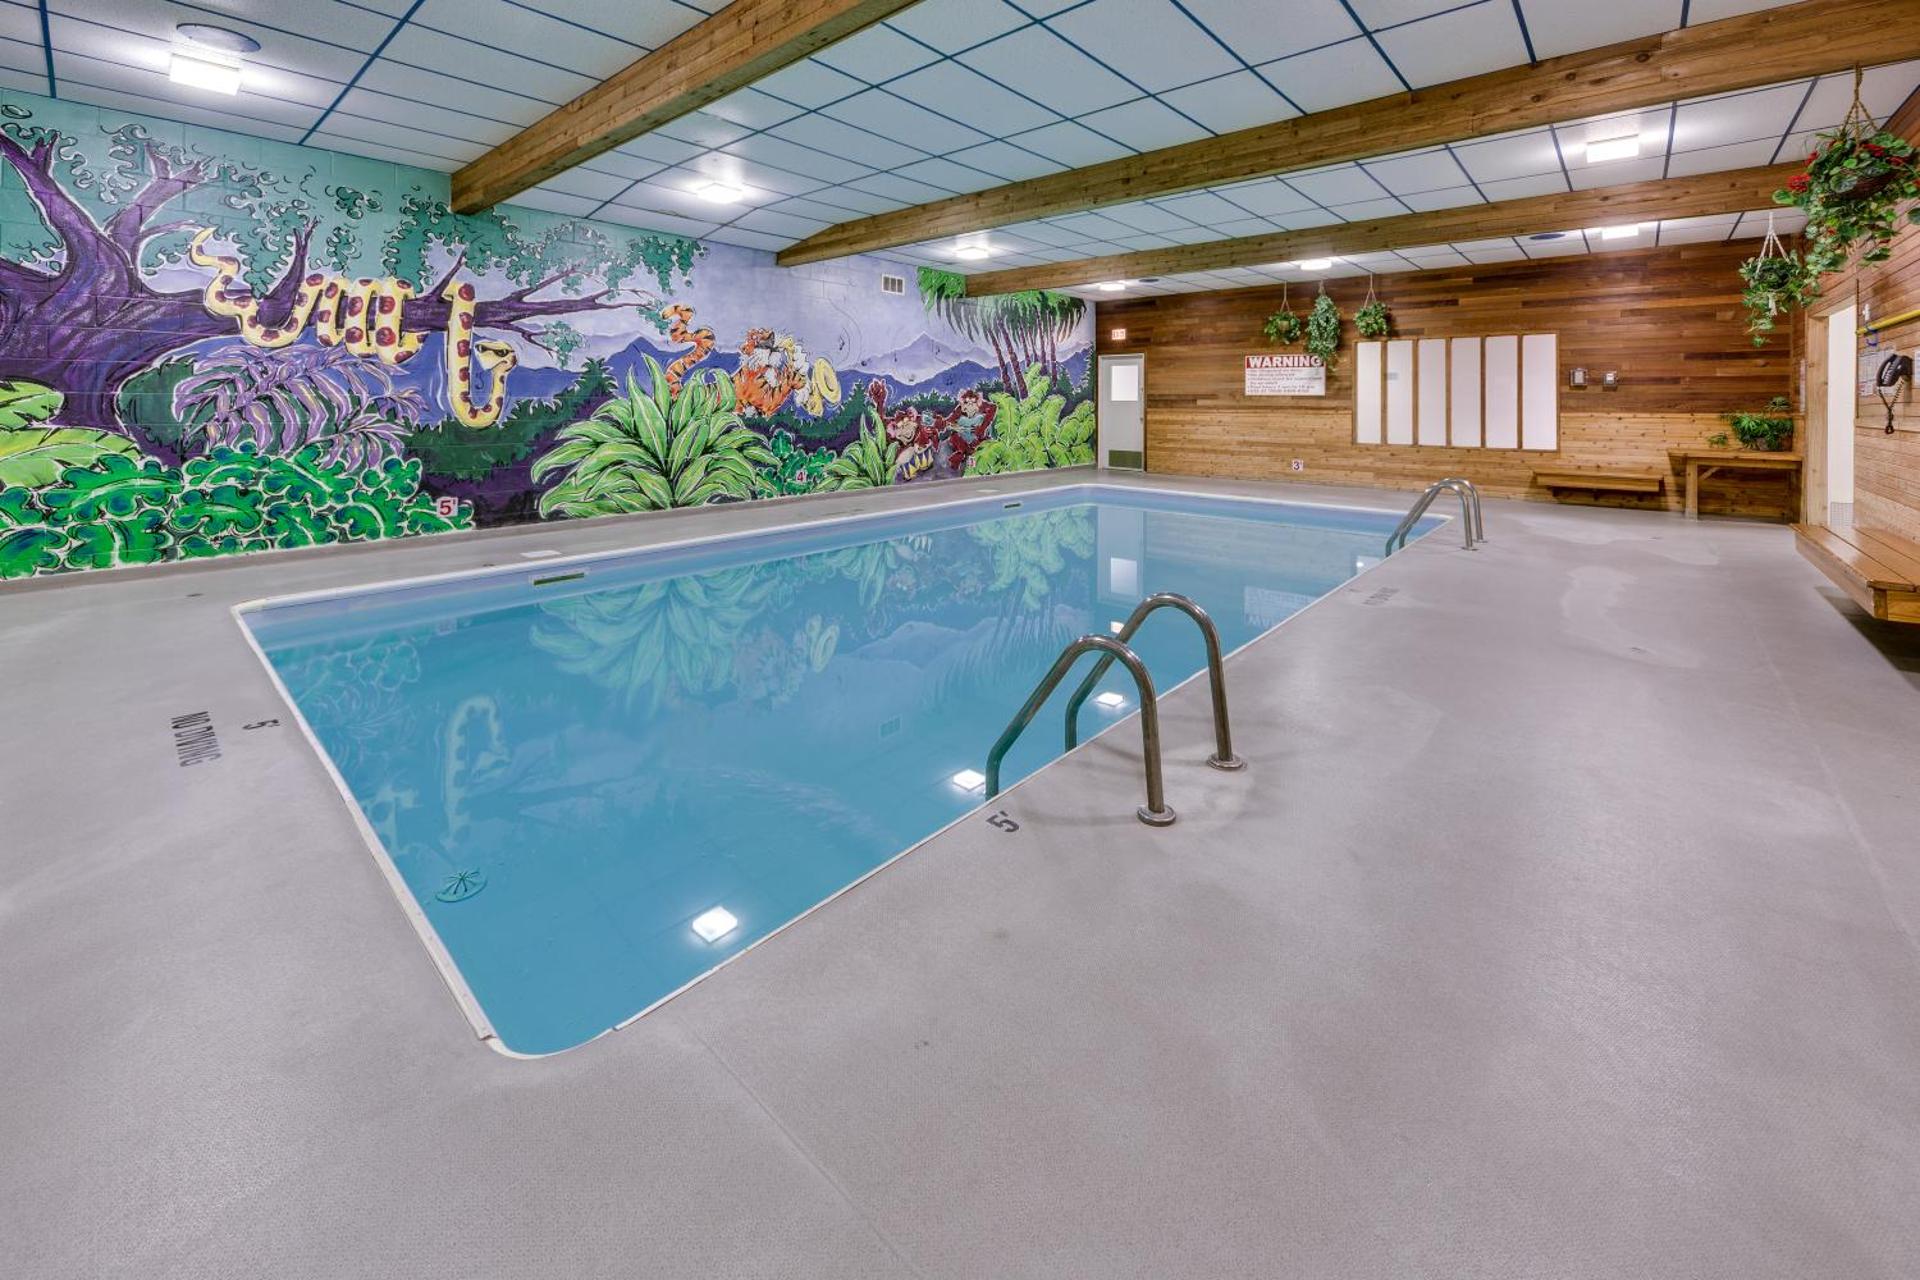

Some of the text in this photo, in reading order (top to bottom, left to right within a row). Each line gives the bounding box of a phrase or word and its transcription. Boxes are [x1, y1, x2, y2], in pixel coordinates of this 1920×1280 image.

[1248, 355, 1323, 368] WARNING
[440, 499, 456, 516] 5'
[170, 710, 223, 768] NO DIVING
[985, 810, 1020, 833] 5'
